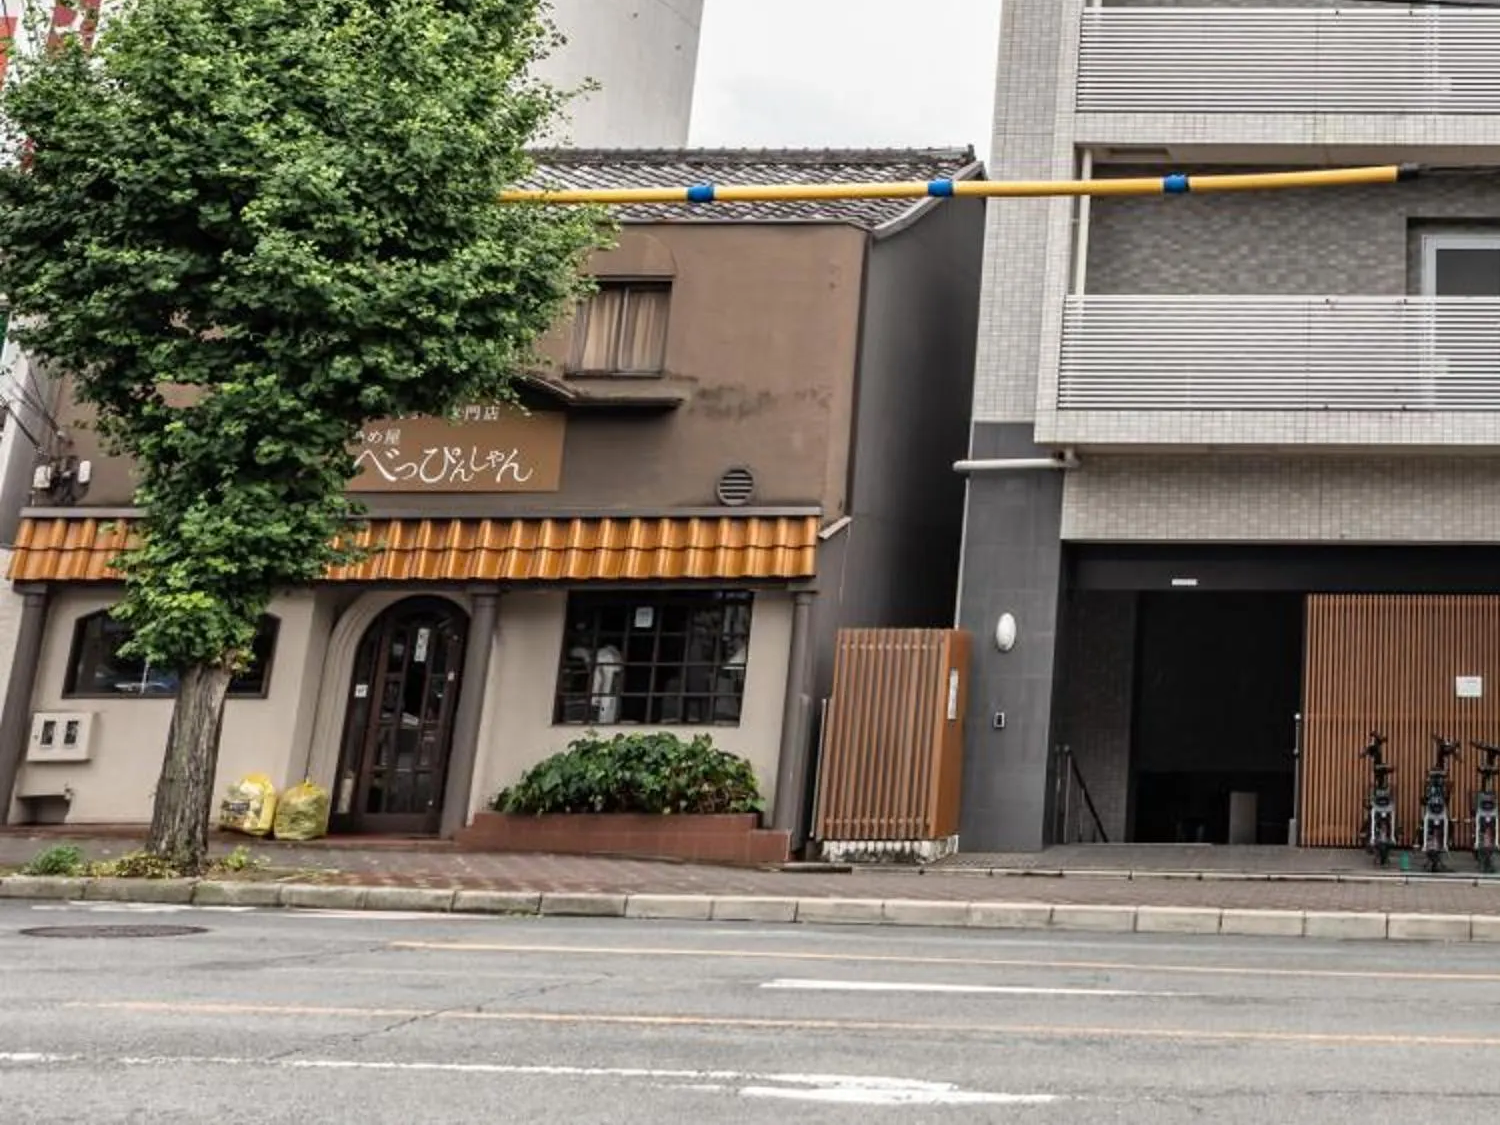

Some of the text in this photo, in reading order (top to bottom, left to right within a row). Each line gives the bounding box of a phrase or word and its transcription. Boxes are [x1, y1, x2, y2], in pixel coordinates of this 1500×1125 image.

[353, 446, 534, 483] べっぴんしゃん
